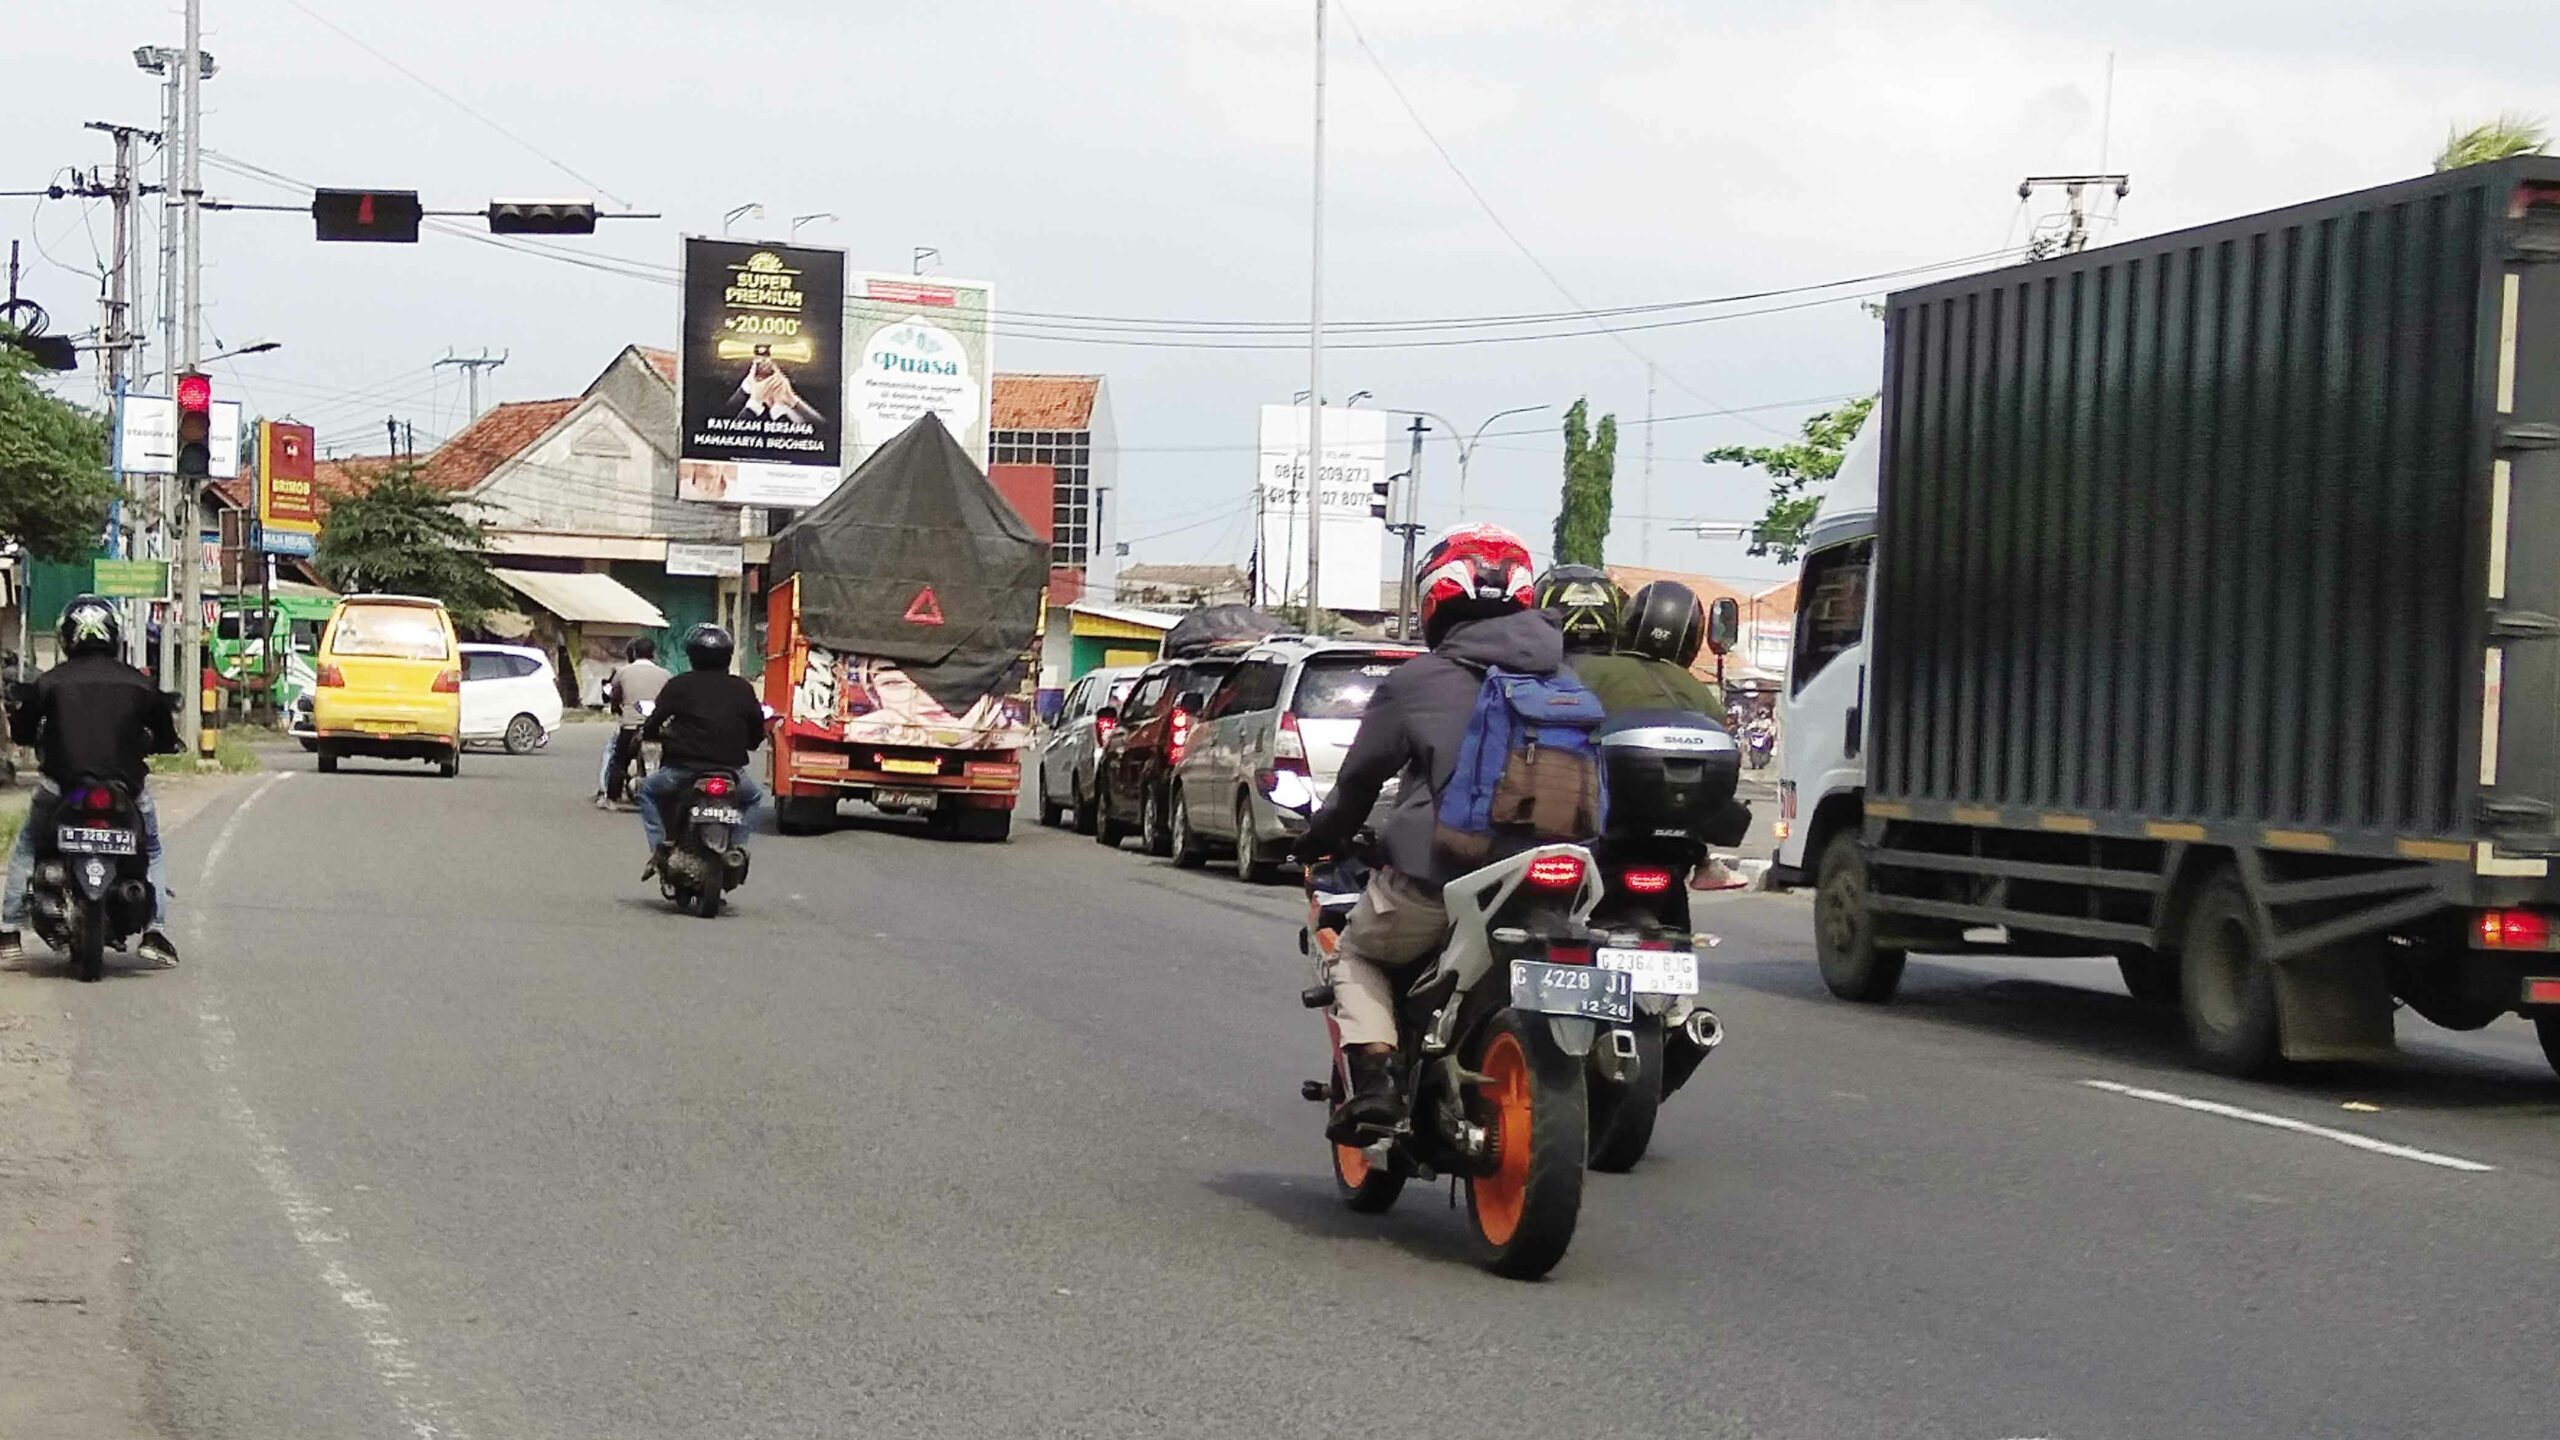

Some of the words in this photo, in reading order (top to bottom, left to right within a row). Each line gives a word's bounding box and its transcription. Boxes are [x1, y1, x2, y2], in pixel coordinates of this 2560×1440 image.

[737, 272, 792, 290] SUPER
[726, 287, 803, 306] PREMIUM
[872, 352, 957, 375] Puasa
[707, 418, 762, 431] RAYAKAN
[763, 420, 814, 435] BERSAMA
[694, 434, 763, 448] MAHAKARYA
[766, 437, 825, 451] INDONESIA
[1541, 968, 1591, 990] 4228
